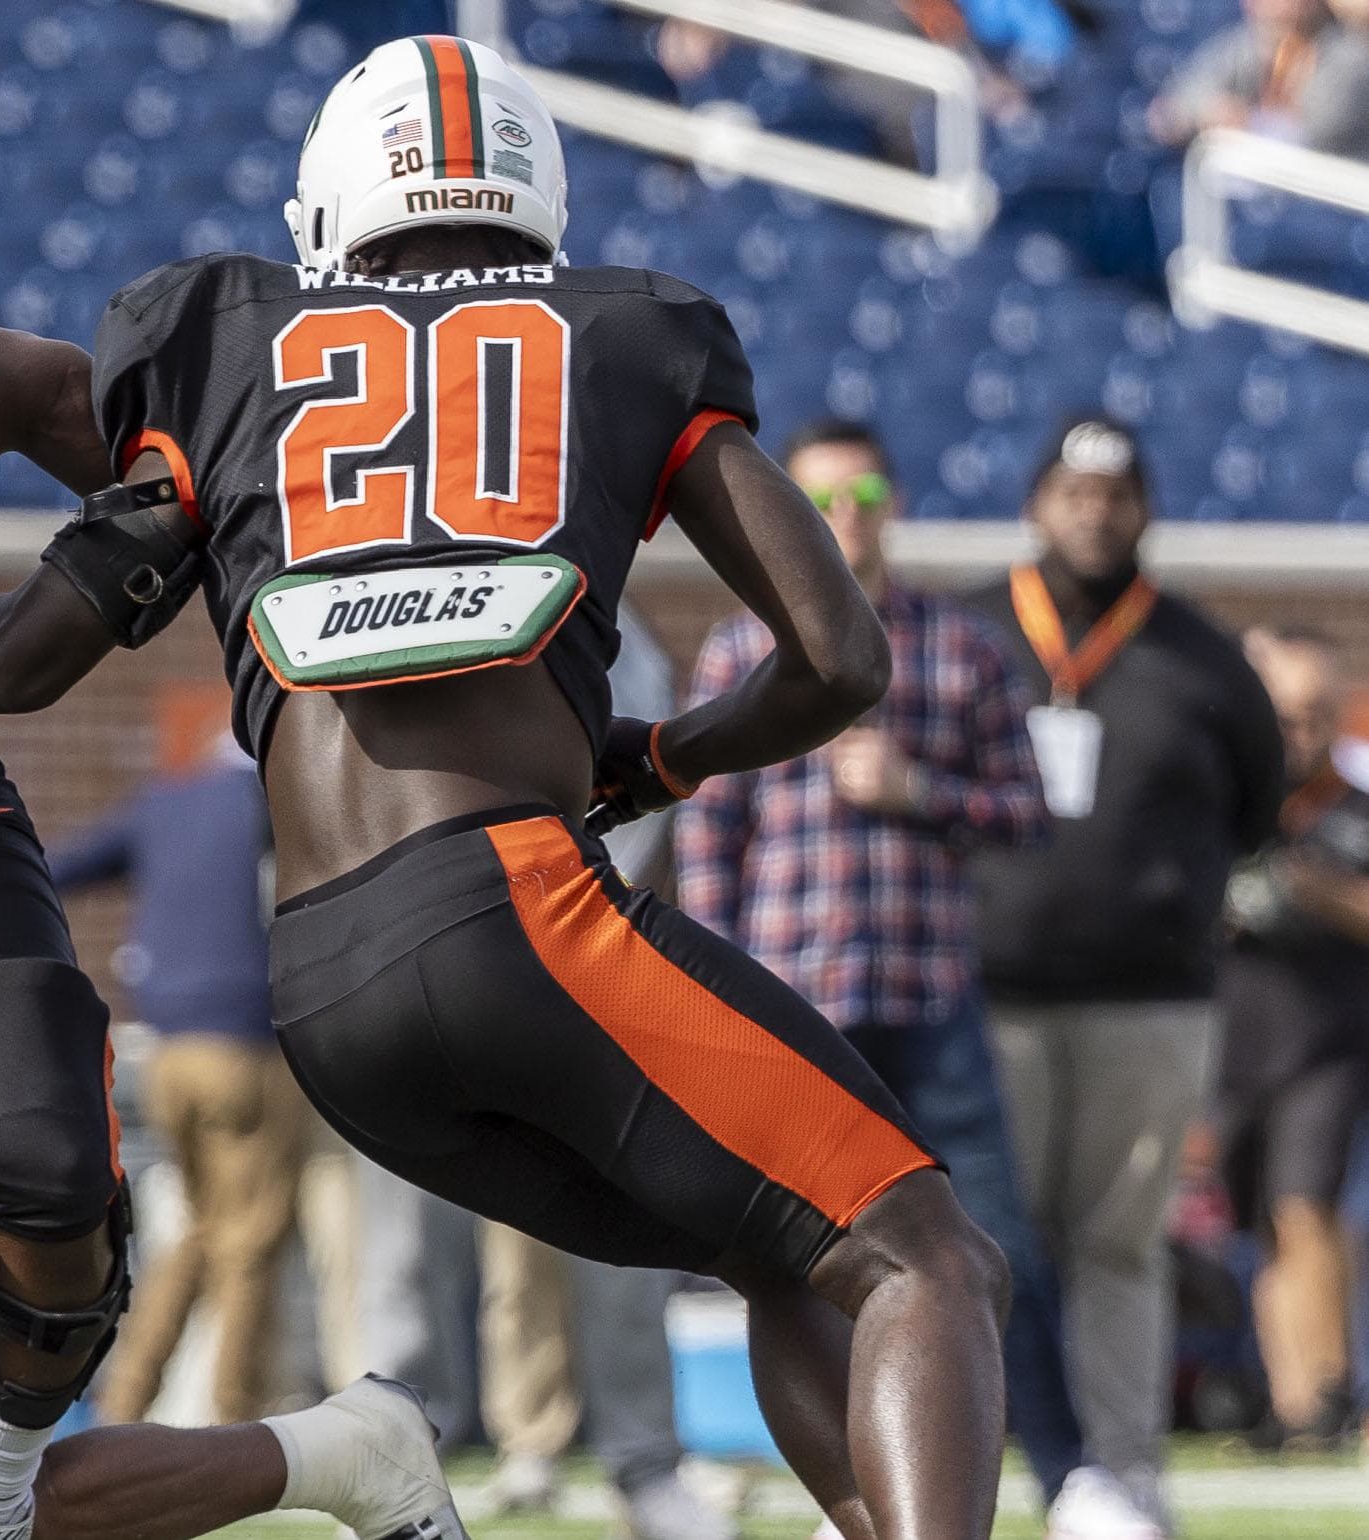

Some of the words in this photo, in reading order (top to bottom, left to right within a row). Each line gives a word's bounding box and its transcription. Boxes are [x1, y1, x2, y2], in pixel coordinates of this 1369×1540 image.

[498, 125, 527, 141] ACC
[388, 146, 424, 179] 20
[292, 264, 555, 293] WILLIAMS
[272, 298, 571, 568] 20
[318, 586, 494, 640] DOUGLAS
